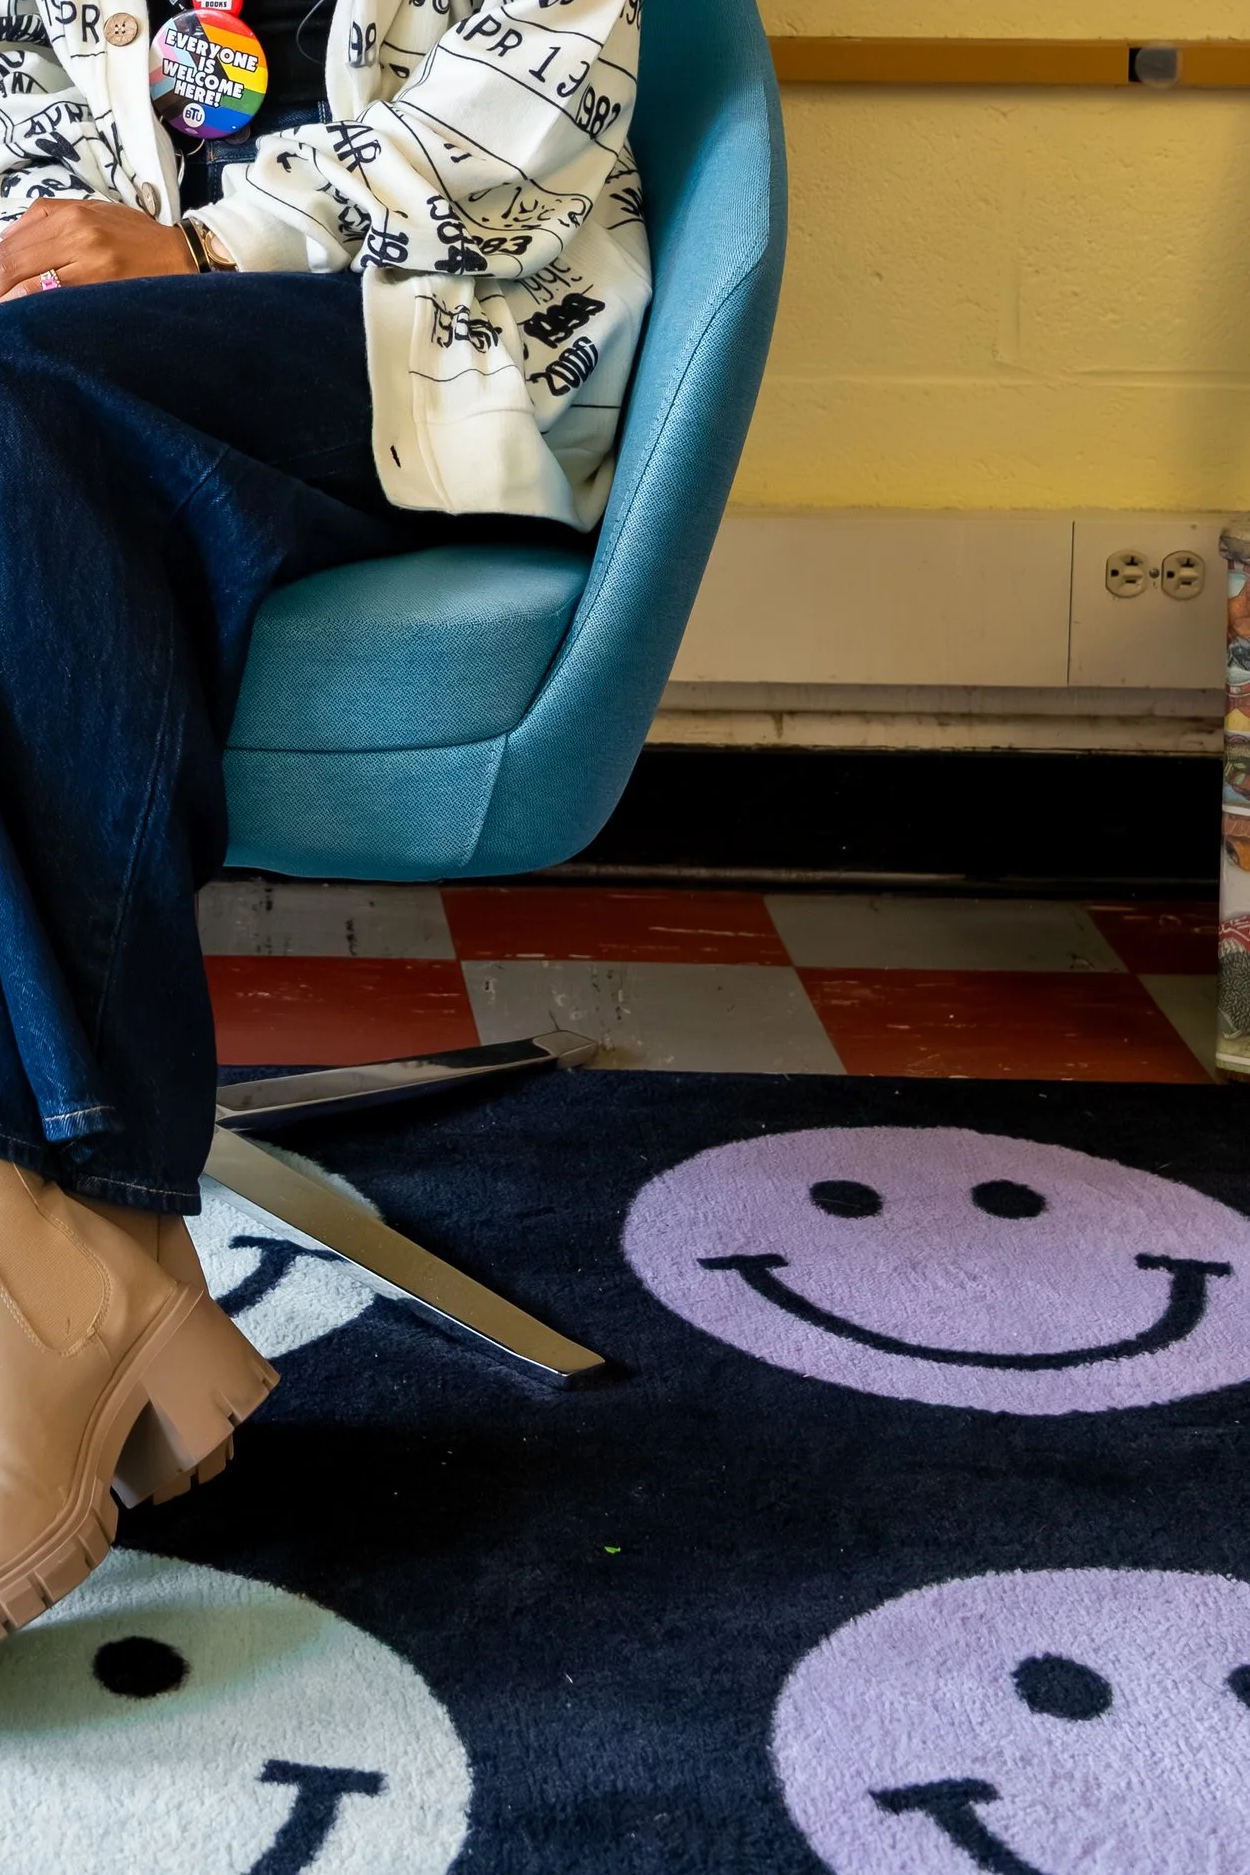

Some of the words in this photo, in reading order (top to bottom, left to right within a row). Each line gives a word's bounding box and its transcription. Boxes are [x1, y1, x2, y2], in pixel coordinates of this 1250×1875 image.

[205, 0, 228, 8] BOOKS
[165, 28, 259, 73] EVERYONE
[197, 55, 216, 75] IS
[162, 58, 244, 99] WELCOME
[174, 79, 223, 108] HERE!
[184, 106, 203, 123] BTU
